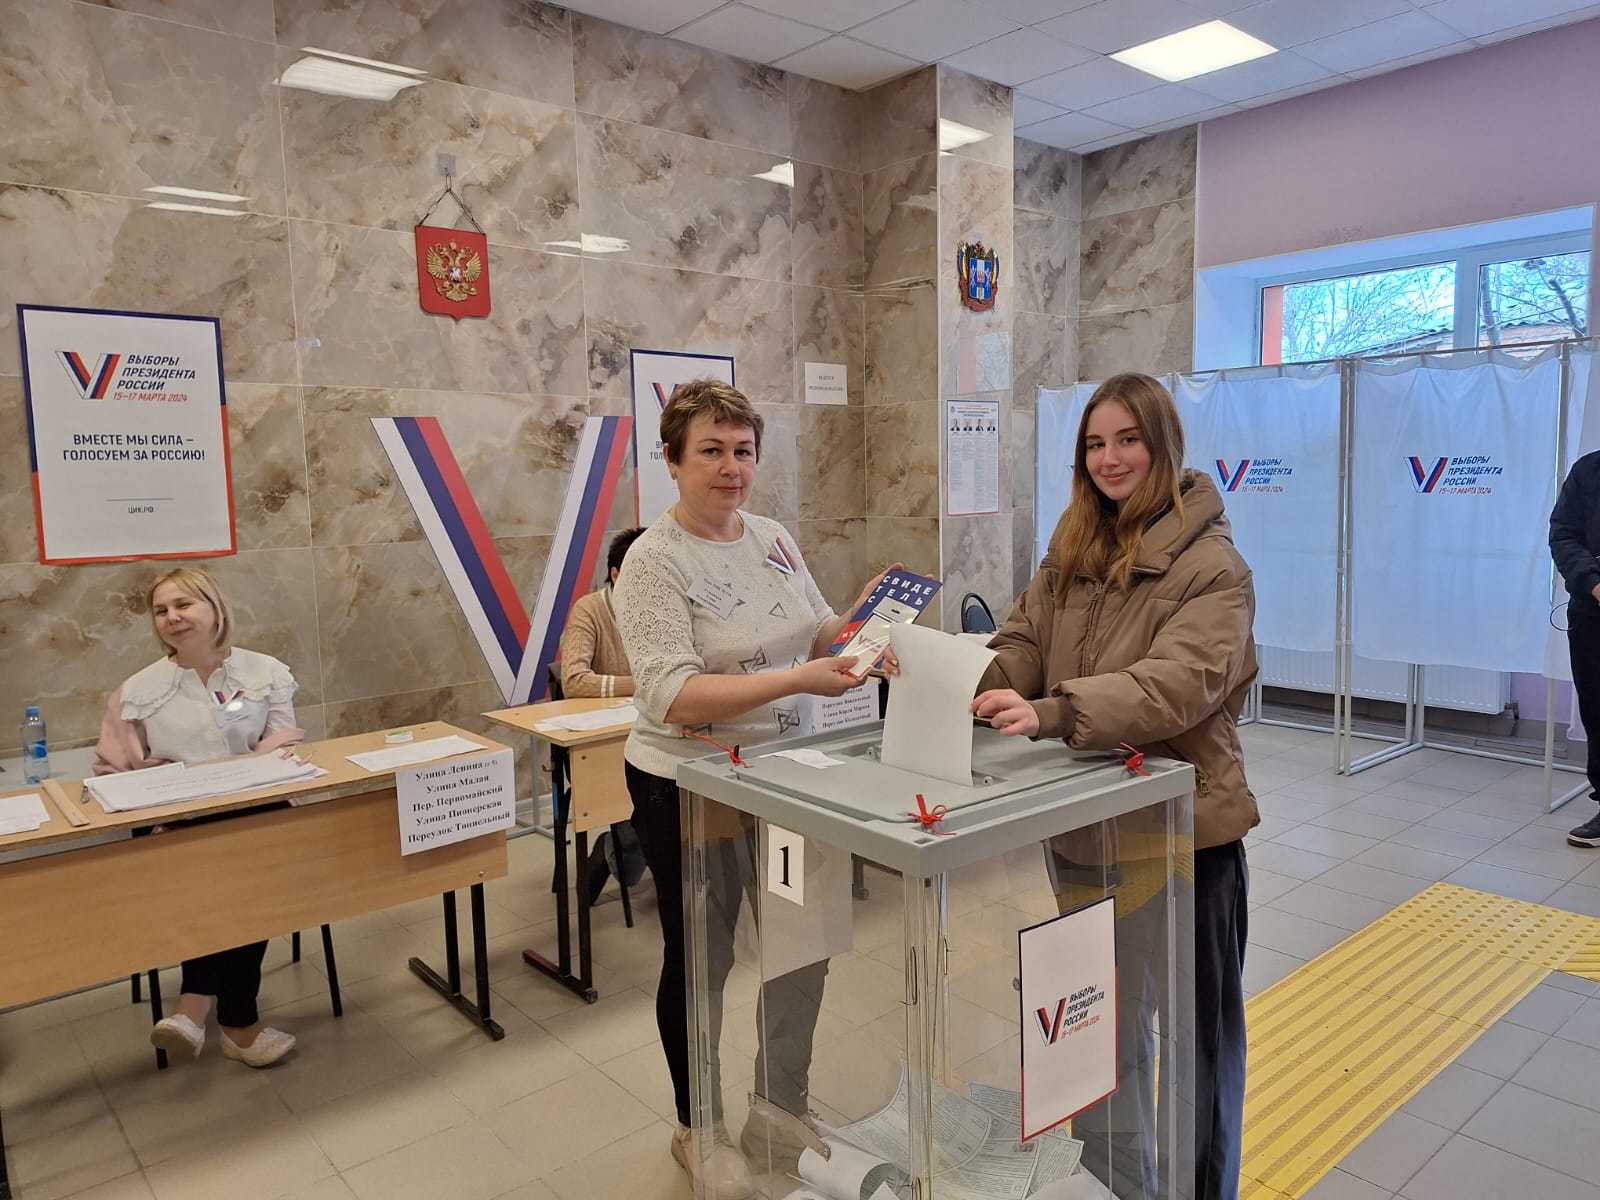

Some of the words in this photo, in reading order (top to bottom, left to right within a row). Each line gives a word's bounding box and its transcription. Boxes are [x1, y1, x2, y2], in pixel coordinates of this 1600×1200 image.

[127, 354, 180, 366] ВЫБОРЫ
[122, 367, 196, 379] ПРЕЗИДЕНТА
[117, 380, 165, 391] РОССИИ
[138, 393, 166, 402] МАРТА
[167, 393, 188, 402] 2024
[73, 434, 123, 446] ВМЕСТЕ
[126, 434, 149, 445] МЫ
[151, 434, 183, 446] СИЛА
[63, 450, 130, 461] ГОЛОСУЕМ
[133, 450, 149, 461] ЗА
[151, 449, 205, 461] РОССИЮ!
[1451, 456, 1491, 466] ВЫБОРЫ
[1252, 459, 1282, 467] ВЫБОРЫ
[1249, 468, 1293, 476] ПРЕЗИДЕНТА
[1448, 467, 1503, 475] ПРЕЗИДЕНТА
[1443, 477, 1477, 486] РОССИИ
[128, 506, 154, 515] ЦИК.РФ
[415, 770, 446, 781] Улица
[448, 763, 483, 775] Ленина
[427, 783, 457, 794] Улица
[459, 775, 489, 786] Малая
[412, 803, 434, 812] Пер.
[437, 785, 503, 806] Первомайский
[416, 815, 446, 826] Улица
[449, 801, 502, 819] Пионерская
[408, 828, 453, 843] Переулок
[455, 811, 510, 831] Тоннельный
[779, 846, 793, 888] 1
[1070, 984, 1097, 1003] ВЫБОРЫ
[1066, 991, 1104, 1015] ПРЕЗИДЕНТА
[1063, 1009, 1088, 1028] РОССИИ
